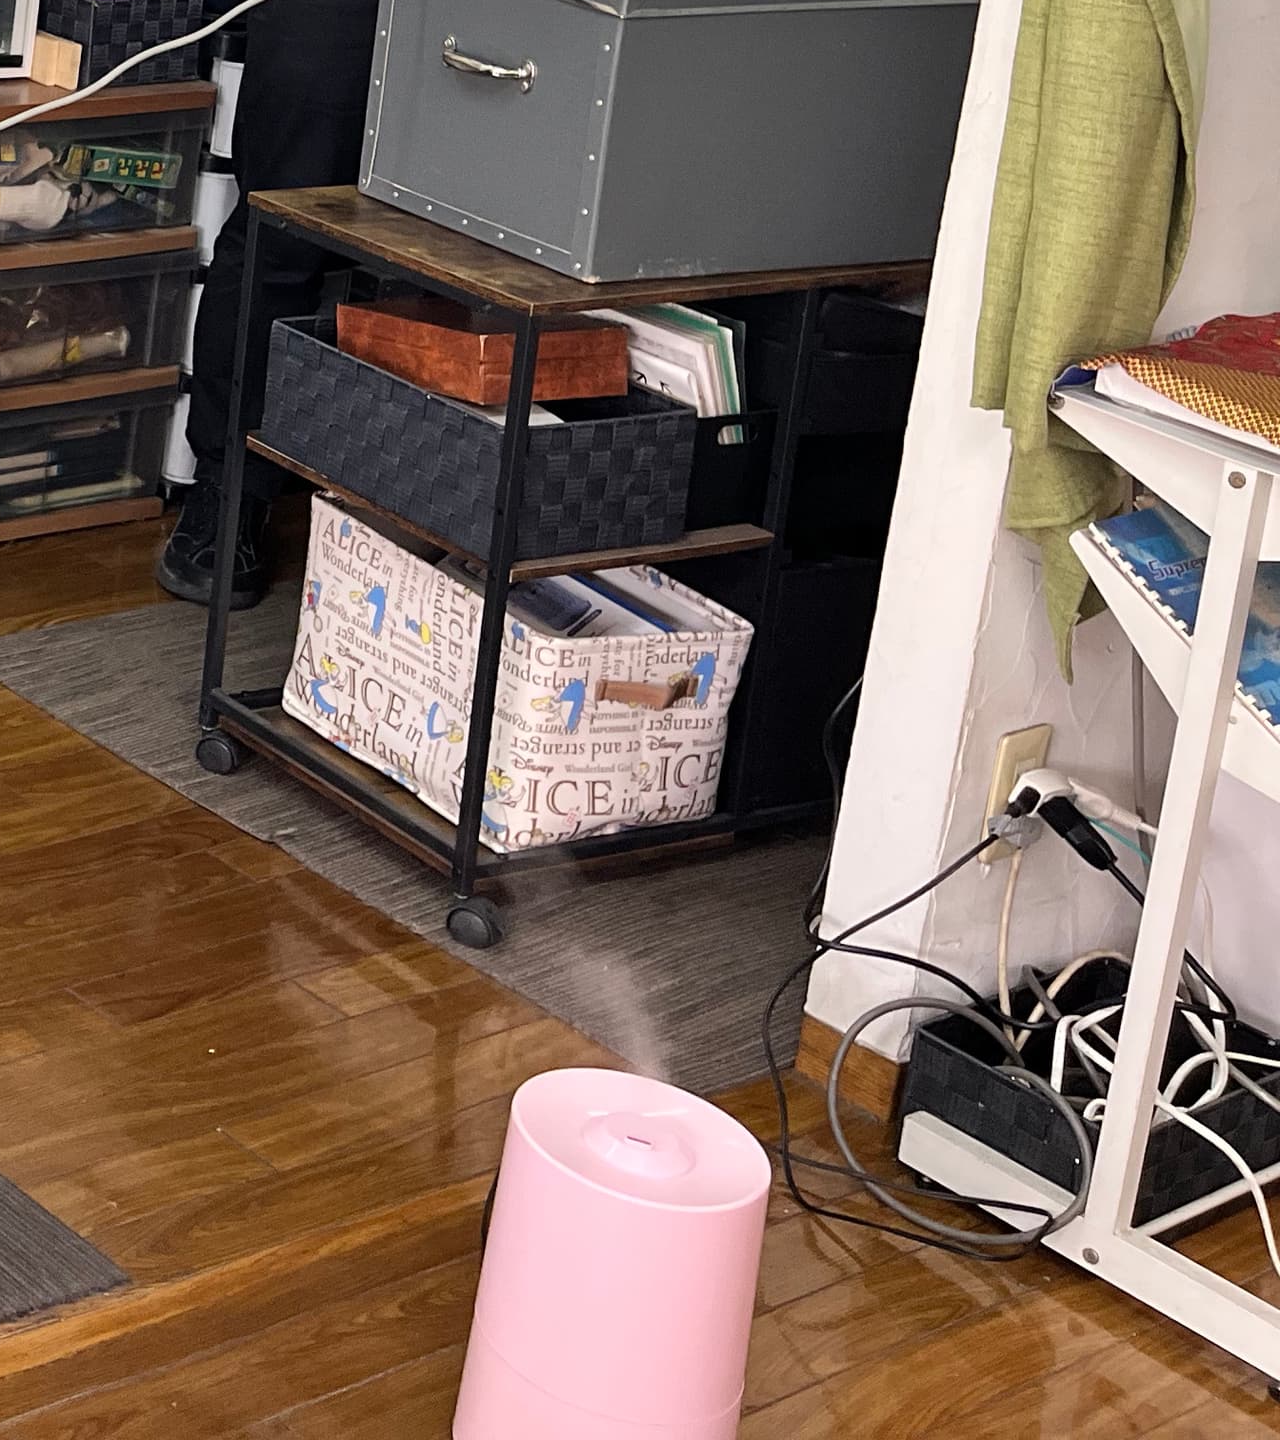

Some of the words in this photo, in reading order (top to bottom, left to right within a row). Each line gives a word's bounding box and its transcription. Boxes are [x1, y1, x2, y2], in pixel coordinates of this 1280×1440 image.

[432, 573, 448, 676] onderland
[447, 587, 466, 661] LICE
[405, 717, 424, 748] in
[591, 741, 622, 761] and
